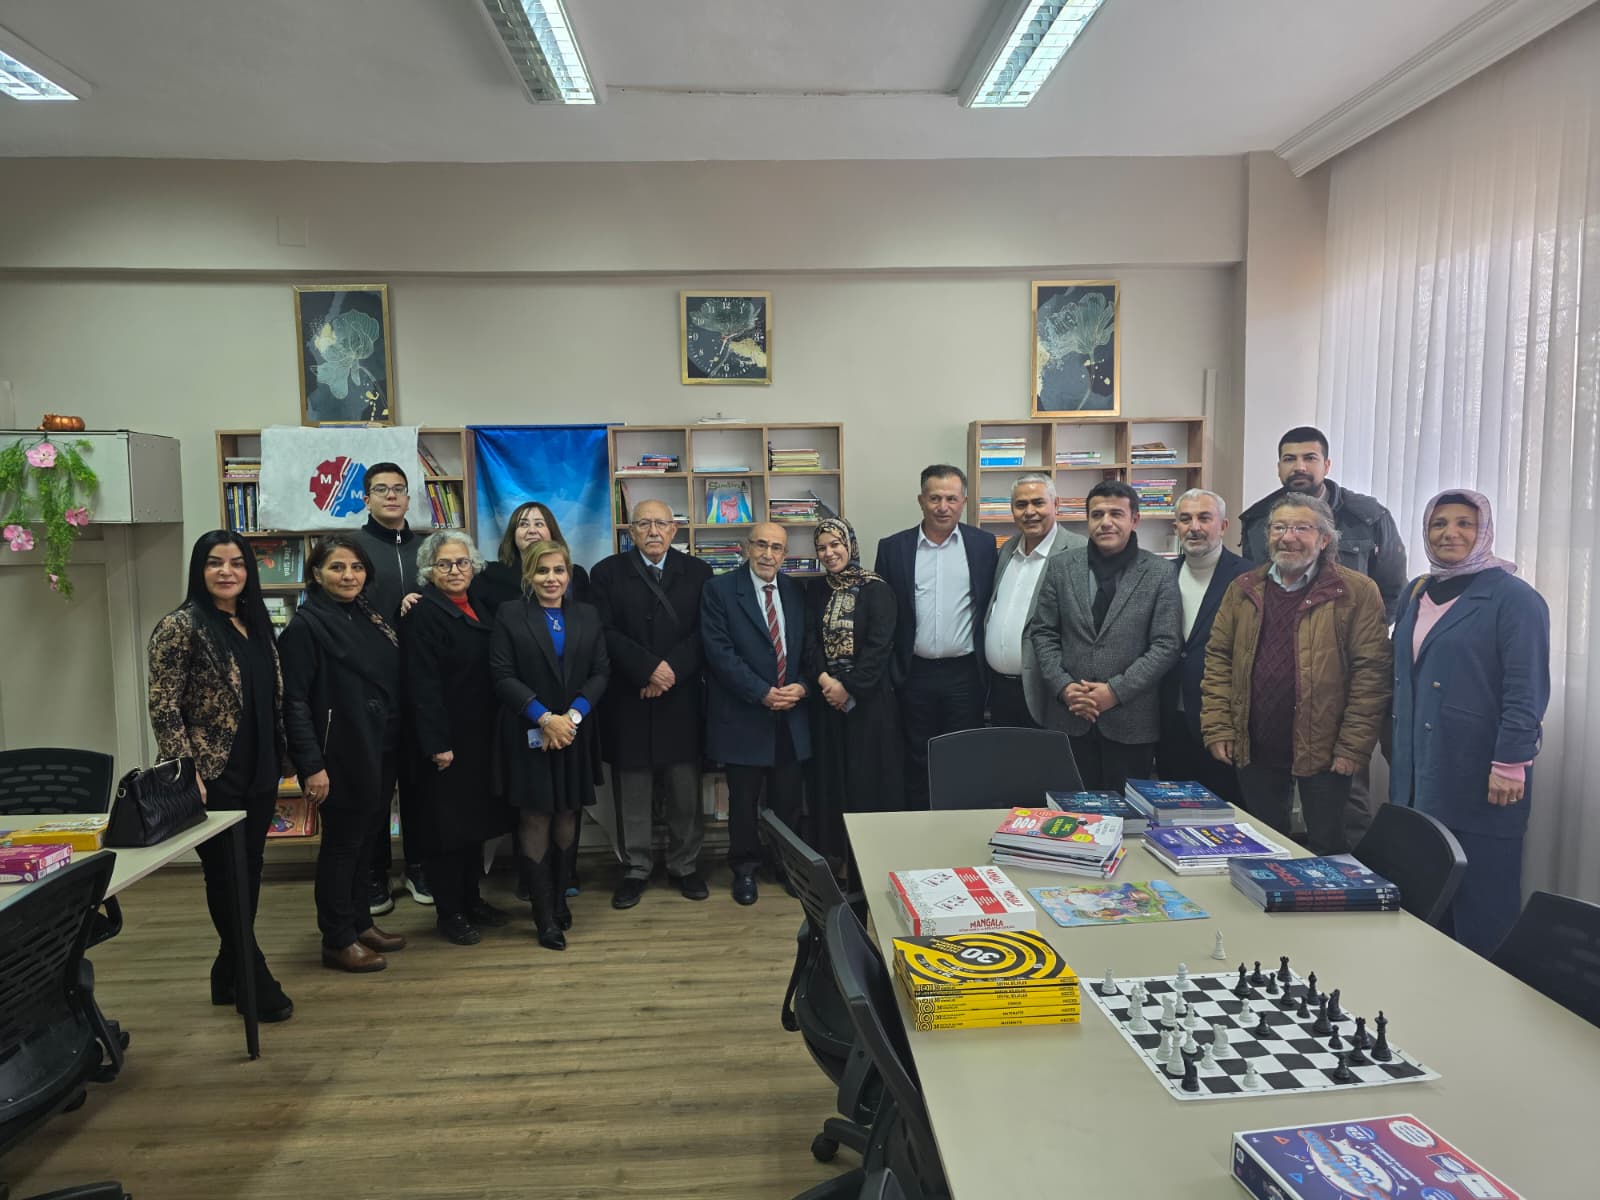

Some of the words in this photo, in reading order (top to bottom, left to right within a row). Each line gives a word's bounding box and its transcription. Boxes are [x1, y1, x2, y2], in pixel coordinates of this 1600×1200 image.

[722, 302, 731, 310] 12
[724, 363, 730, 372] 6
[320, 473, 332, 484] M
[351, 490, 364, 499] M
[970, 918, 1004, 929] MANGALA
[960, 947, 1001, 964] 30
[1340, 1155, 1382, 1184] Party
